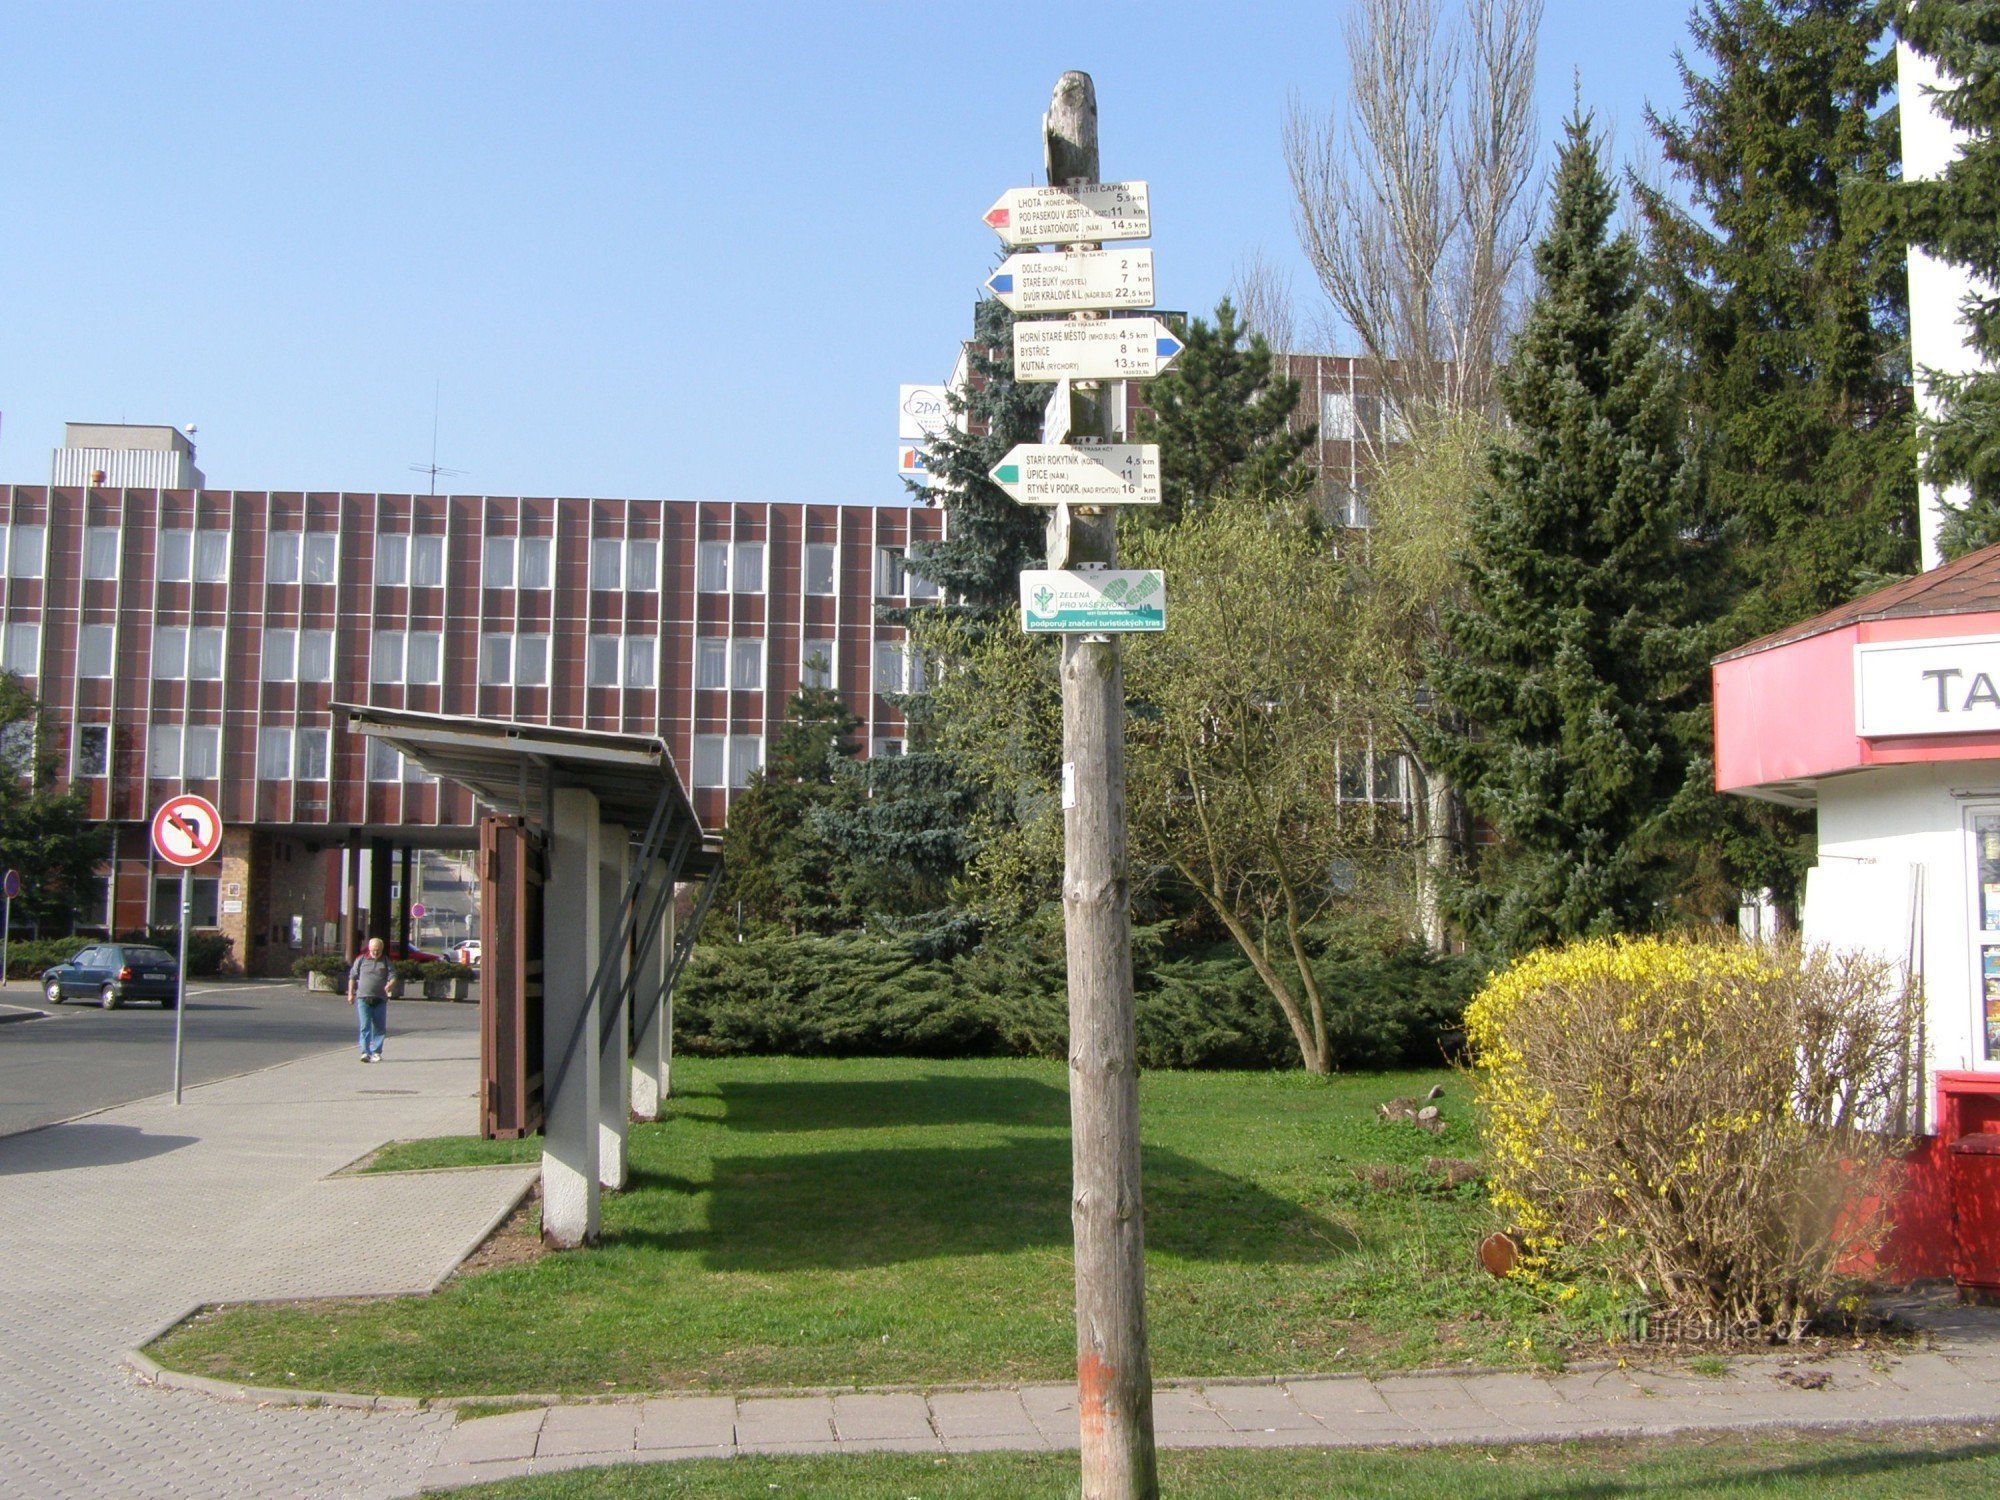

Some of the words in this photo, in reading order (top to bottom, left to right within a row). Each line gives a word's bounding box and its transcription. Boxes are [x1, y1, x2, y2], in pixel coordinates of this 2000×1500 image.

[1018, 199, 1041, 208] LHOTA
[1044, 199, 1065, 207] (KONEC
[1116, 193, 1130, 203] 5,5
[1019, 212, 1031, 221] POD
[1032, 210, 1059, 220] PASEKOU
[1060, 210, 1065, 219] V
[1110, 207, 1122, 216] 11
[1020, 224, 1037, 235] MALÉ
[1039, 222, 1084, 234] SVATOŇOVIC
[1111, 220, 1132, 230] 14,5
[1022, 263, 1041, 273] DOLCE
[1121, 260, 1128, 269] 2
[1022, 277, 1041, 287] STARÉ
[1060, 278, 1087, 287] (KOSTEL)
[1122, 274, 1128, 283] 7
[1023, 290, 1040, 301] DVŮR
[1042, 289, 1070, 300] KRÁLOVÉ
[1116, 288, 1136, 298] 22,5
[1020, 331, 1040, 342] HORNÍ
[1042, 329, 1063, 341] STARÉ
[1064, 329, 1086, 341] MĚSTO
[1120, 330, 1134, 339] 4,5
[1020, 345, 1050, 356] BYSTŘICE
[1121, 344, 1127, 354] 8
[1021, 359, 1045, 371] KUTNÁ
[1114, 358, 1135, 368] 13,5
[915, 402, 941, 414] ZPA
[1026, 453, 1046, 465] STARÝ
[1047, 453, 1079, 465] ROKYTNÍK
[1081, 458, 1104, 466] (KOSTEL)
[1125, 455, 1141, 466] 4,5
[1026, 467, 1048, 480] ÚPICE
[1049, 471, 1069, 481] (NÁM.)
[1120, 470, 1132, 479] 11
[1027, 481, 1049, 494] RTYNĚ
[1050, 483, 1055, 493] V
[1056, 483, 1081, 494] PODKR.
[1121, 483, 1135, 494] 16
[1059, 591, 1090, 599] ZELENÁ
[1078, 600, 1099, 608] VAŠE
[1030, 620, 1067, 628] podporují
[1068, 619, 1098, 627] značení
[1099, 619, 1144, 628] turistických
